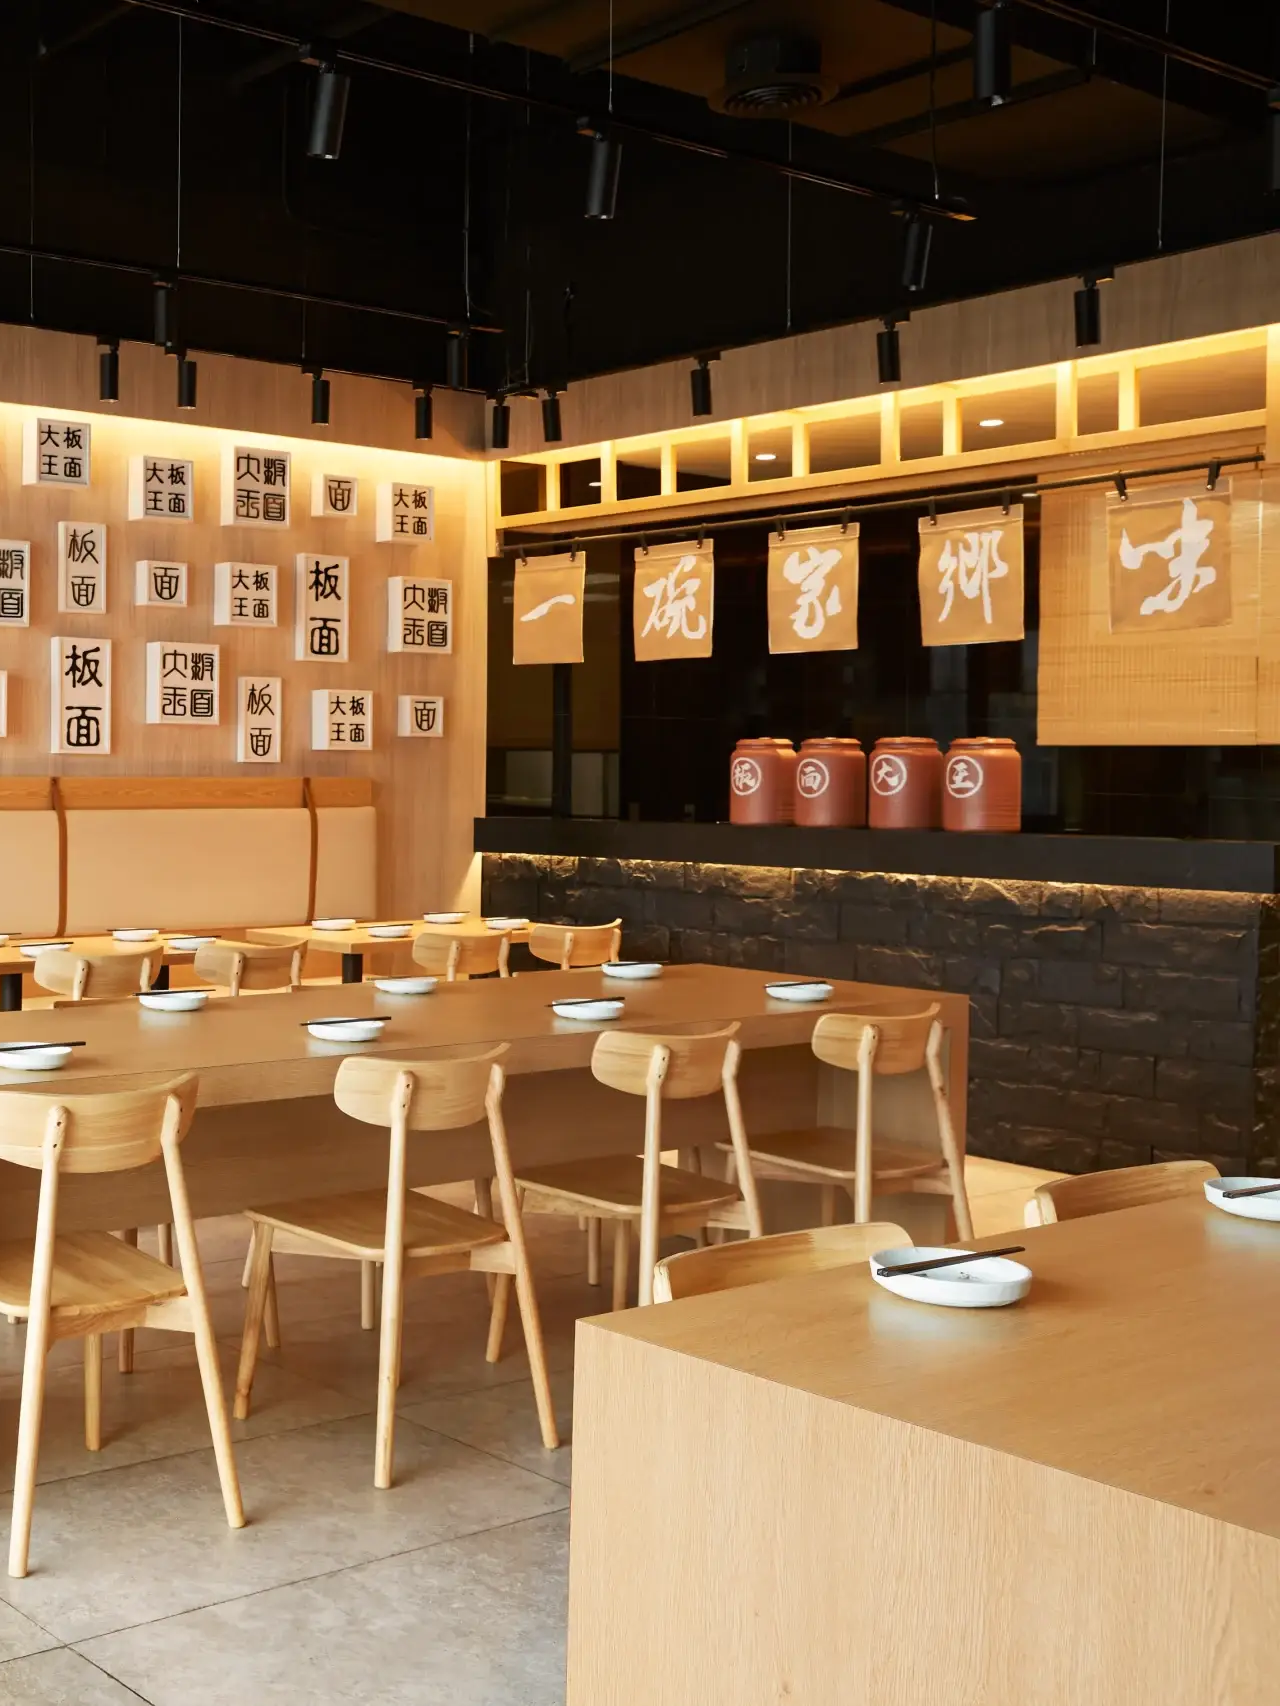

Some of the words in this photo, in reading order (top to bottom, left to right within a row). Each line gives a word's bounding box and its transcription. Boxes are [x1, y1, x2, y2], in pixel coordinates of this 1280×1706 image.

[328, 480, 351, 511] 面
[68, 529, 98, 606] 板面
[1119, 497, 1218, 616] 味
[154, 567, 179, 600] 面
[641, 554, 706, 640] 碗
[783, 546, 843, 639] 家
[309, 561, 341, 655] 板面
[520, 594, 576, 622] 一
[65, 645, 102, 746] 板面
[247, 684, 274, 756] 板面
[414, 701, 436, 731] 面
[733, 763, 757, 789] 板
[800, 766, 822, 790] 面
[876, 761, 900, 785] 大
[950, 762, 974, 788] 王
